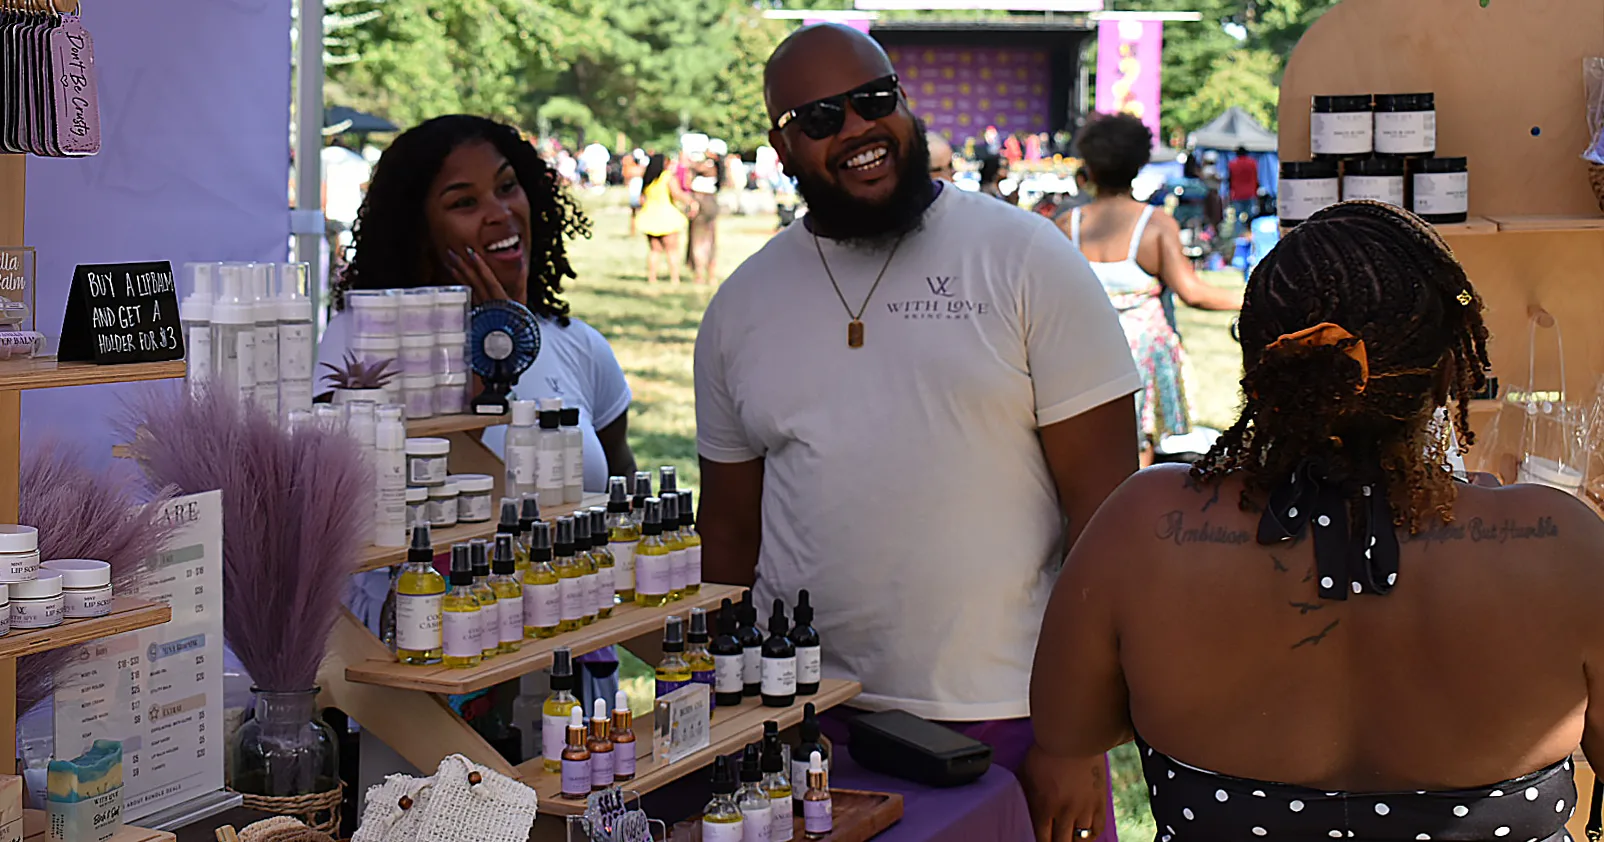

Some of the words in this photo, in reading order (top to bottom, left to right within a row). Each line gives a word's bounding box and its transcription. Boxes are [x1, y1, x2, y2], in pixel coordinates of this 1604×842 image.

[66, 32, 86, 73] Don't
[69, 73, 87, 94] Be
[70, 97, 90, 137] Crusty
[0, 252, 19, 271] lla
[88, 272, 115, 297] BUY
[125, 272, 135, 297] A
[92, 307, 116, 328] AND
[118, 305, 141, 329] GET
[152, 300, 161, 322] A
[887, 301, 938, 313] WITH
[946, 300, 989, 314] LOVE
[98, 334, 136, 354] HOLDER
[139, 331, 159, 351] FOR
[160, 327, 177, 350] $3
